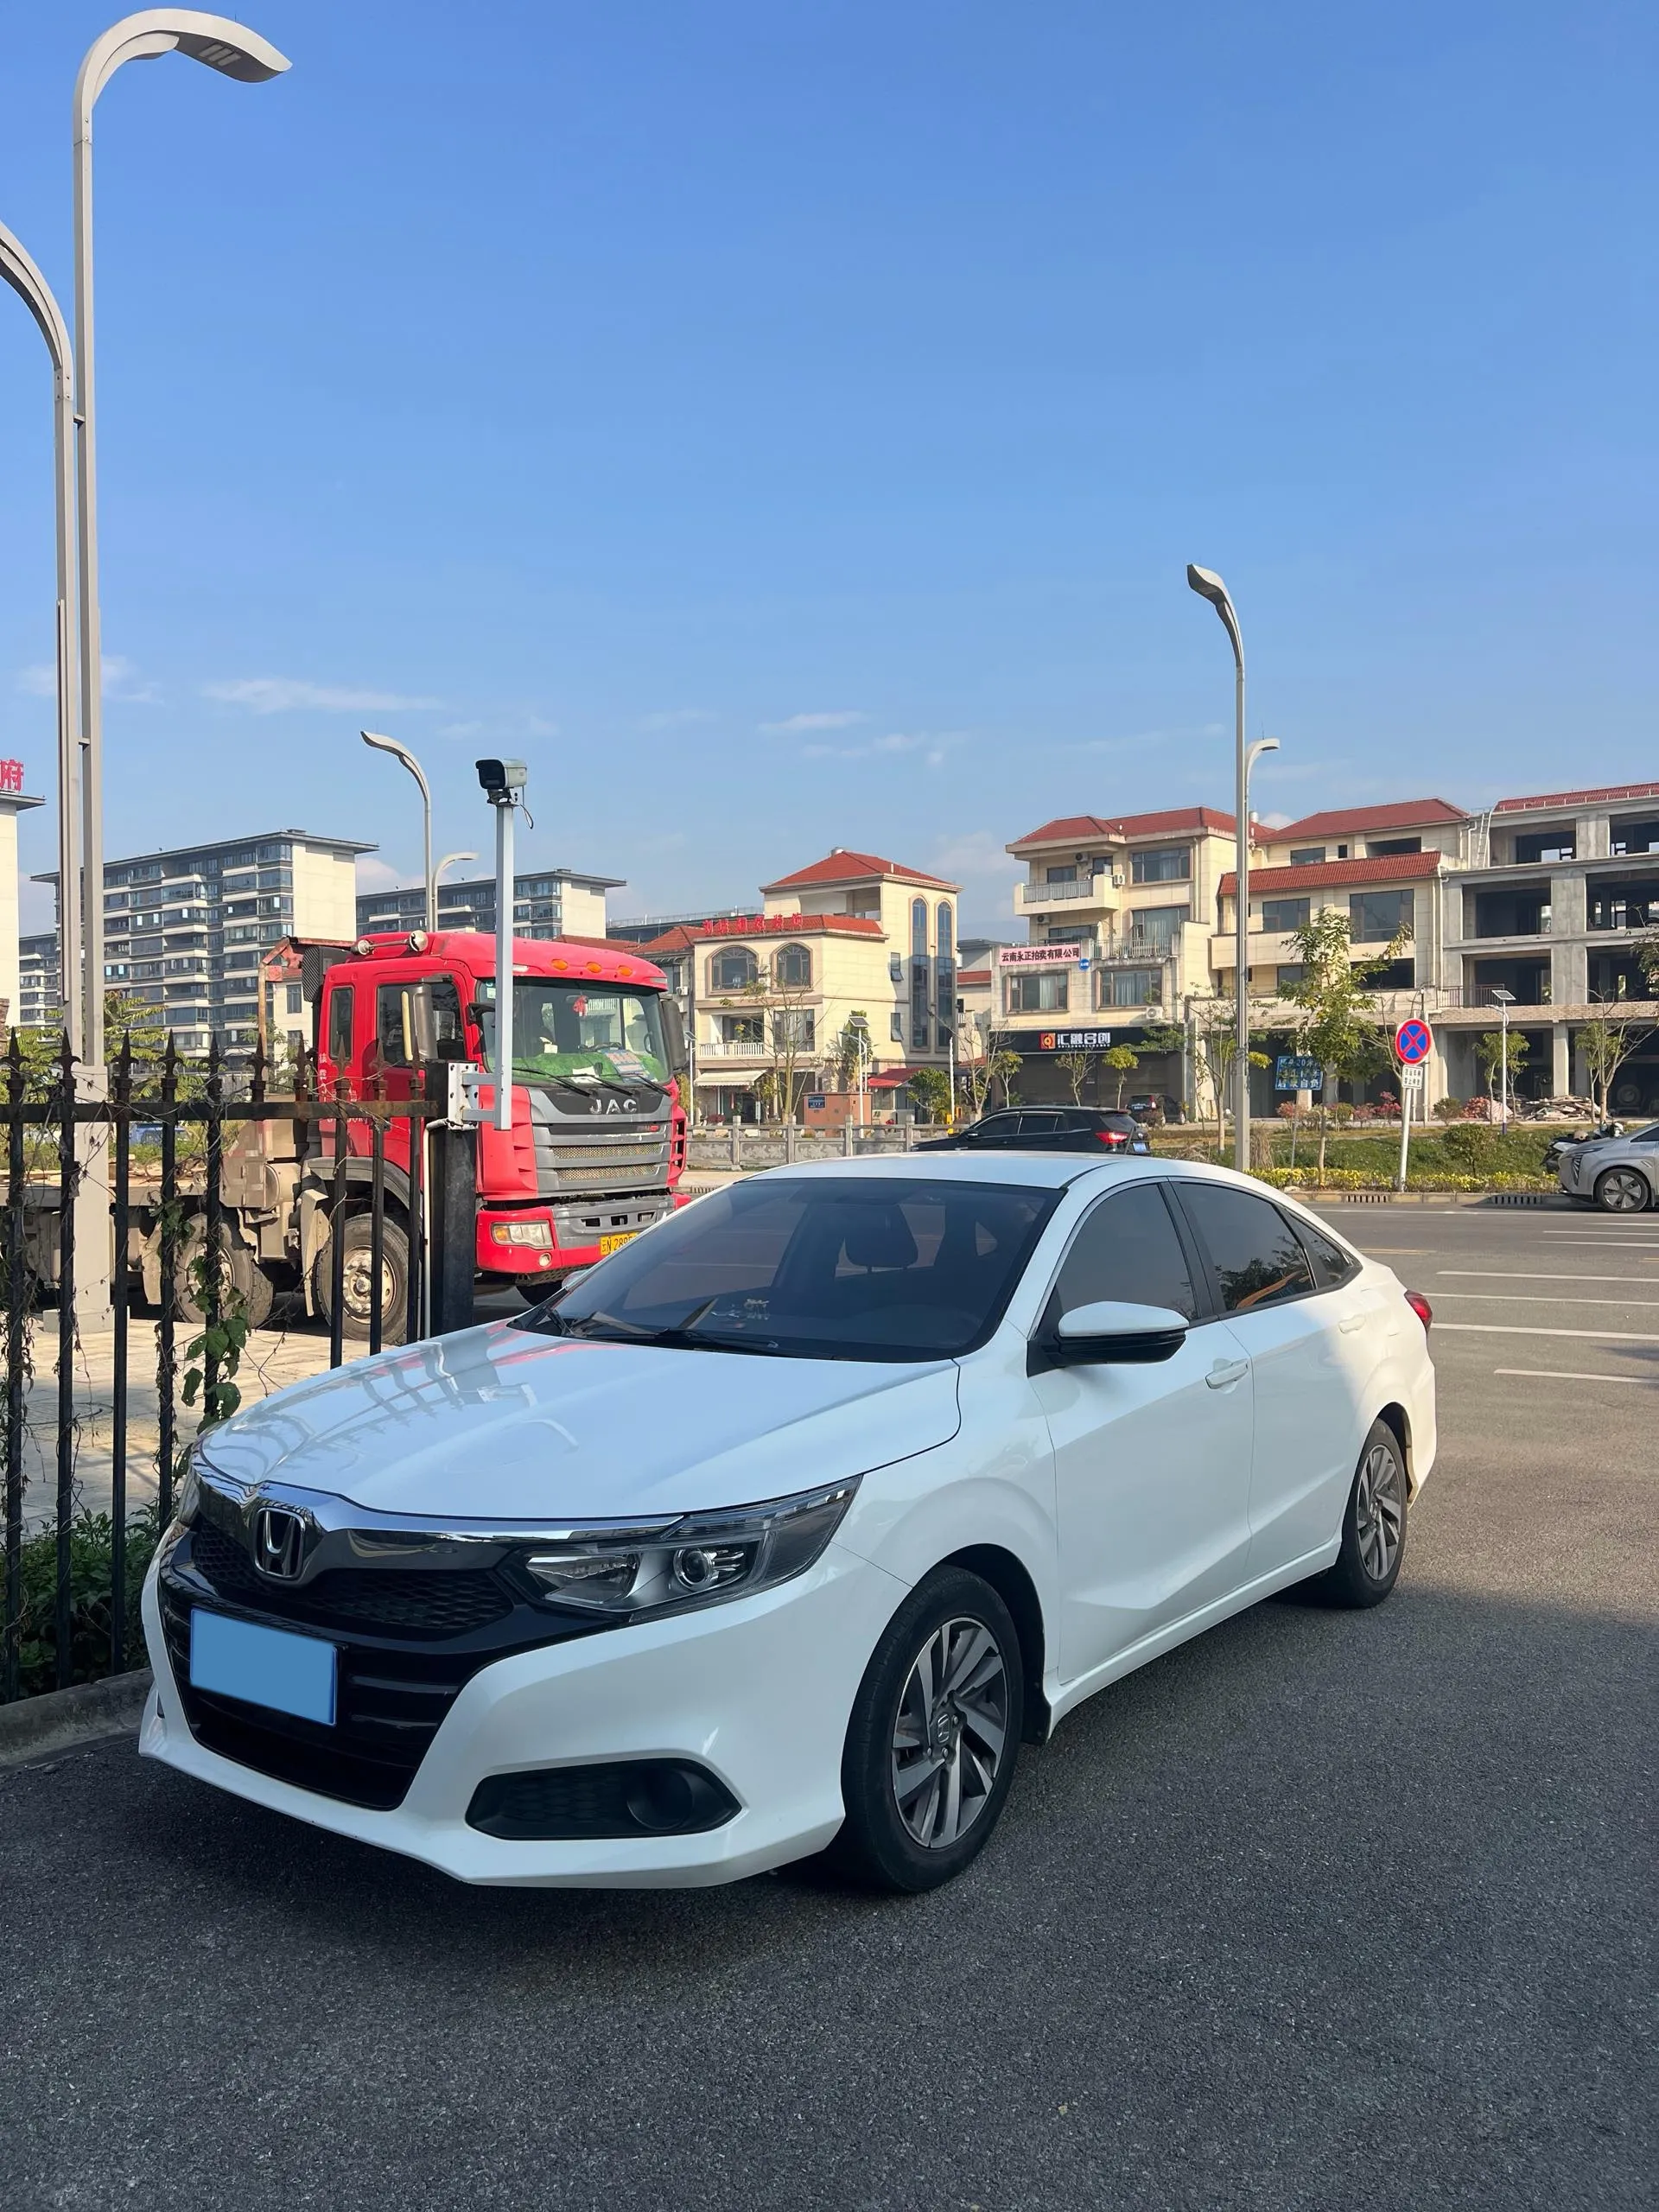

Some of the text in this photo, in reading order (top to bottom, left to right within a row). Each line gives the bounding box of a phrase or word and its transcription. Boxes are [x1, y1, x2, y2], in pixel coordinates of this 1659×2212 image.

[1001, 948, 1080, 963] 云南永正拍卖有限公司
[1057, 1032, 1111, 1046] 汇融合创
[589, 1098, 638, 1115] JAC
